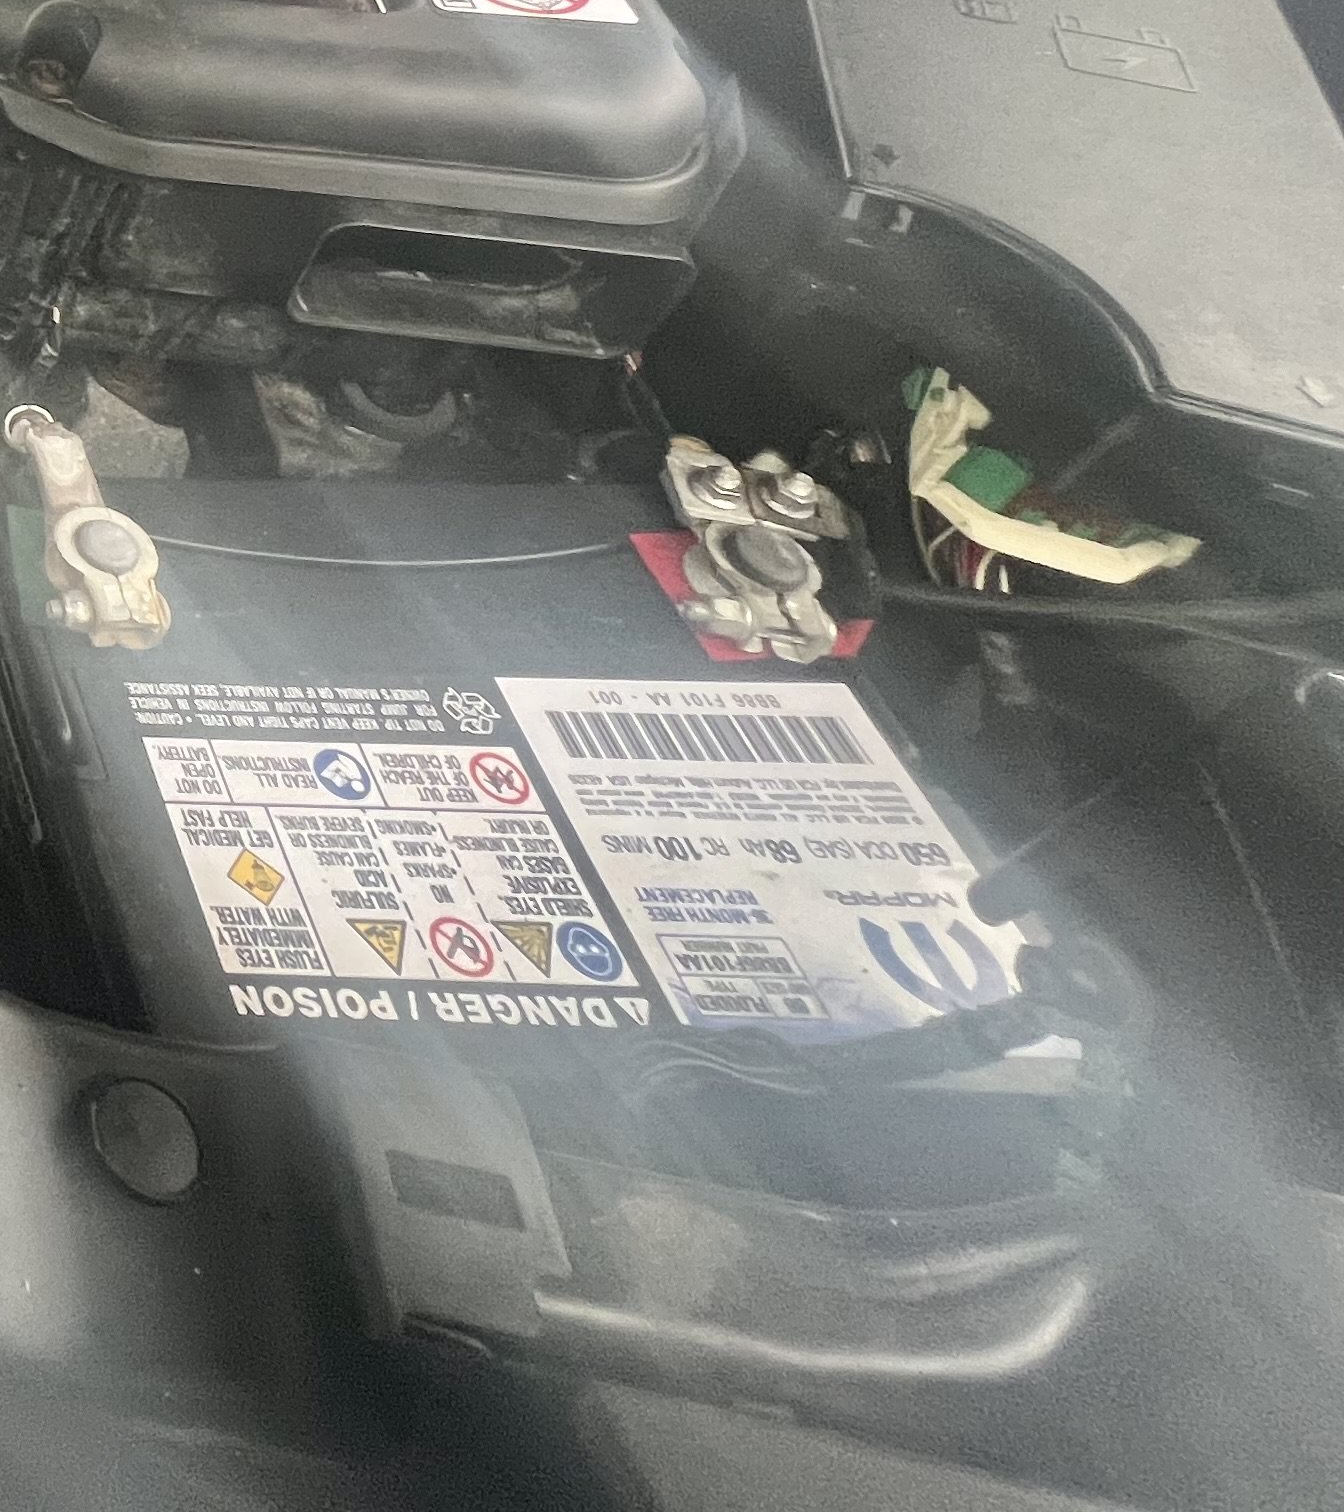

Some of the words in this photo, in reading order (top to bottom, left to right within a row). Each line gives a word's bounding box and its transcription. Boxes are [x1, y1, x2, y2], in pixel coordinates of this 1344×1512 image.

[192, 685, 219, 696] SEEK
[282, 687, 304, 698] NOT
[316, 688, 334, 699] OR
[334, 688, 380, 700] MANUAL
[588, 690, 622, 705] 001
[128, 697, 172, 710] VEHICLE
[176, 699, 190, 710] IN
[194, 699, 269, 712] INSTRUCTIONS
[646, 692, 671, 706] AA
[680, 692, 726, 706] F101
[274, 701, 318, 714] FOLLOW
[321, 702, 375, 715] STARTING
[413, 705, 437, 716] FOR
[232, 715, 254, 727] AND
[258, 716, 289, 728] TIGHT
[290, 717, 320, 729] CAPS
[321, 718, 350, 729] VENT
[352, 718, 380, 730] KEEP
[404, 719, 428, 731] NOT
[427, 720, 445, 732] DO
[152, 744, 208, 762] BATTERY.
[180, 762, 215, 776] OPEN
[217, 755, 311, 772] INSTRUCTIONS.
[374, 754, 446, 770] CHILDREN.
[446, 756, 462, 771] OF
[253, 772, 278, 788] ALL
[282, 774, 318, 789] READ
[380, 768, 427, 785] REACH
[424, 770, 454, 786] THE
[453, 772, 469, 786] OF
[175, 778, 201, 793] NOT
[202, 779, 222, 794] DO
[415, 787, 444, 802] OUT
[446, 788, 479, 802] KEEP
[179, 808, 211, 826] FAST
[218, 810, 250, 828] HELP
[320, 816, 365, 832] SEVERE
[529, 820, 550, 835] OR
[181, 828, 244, 847] MEDICAL
[244, 829, 274, 847] GET
[287, 832, 307, 847] OR
[308, 834, 373, 849] BLINDNESS
[602, 834, 652, 854] MINS
[519, 838, 559, 853] CAUSE
[654, 836, 702, 860] 100
[701, 838, 726, 856] RC
[803, 836, 853, 859] (SAE)
[856, 841, 898, 859] CCA
[313, 851, 353, 866] CAUSE
[353, 852, 380, 866] CAN
[900, 842, 951, 865] 650
[496, 855, 524, 871] CAN
[523, 856, 570, 874] GASES
[354, 869, 388, 887] ACID
[502, 875, 582, 896] EXPLOSIVE
[331, 890, 399, 910] SULFURIC
[430, 884, 454, 903] NO
[634, 887, 760, 905] REPLACEMENT
[836, 890, 959, 908] MOPAR
[210, 905, 266, 924] WATER.
[541, 898, 593, 917] SHIELD
[643, 906, 686, 922] FREE
[266, 907, 308, 926] WITH
[215, 926, 316, 948] IMMEDIATELY
[236, 948, 272, 967] EYES
[274, 950, 324, 970] FLUSH
[228, 984, 399, 1020] POISON
[428, 992, 617, 1028] DANGER
